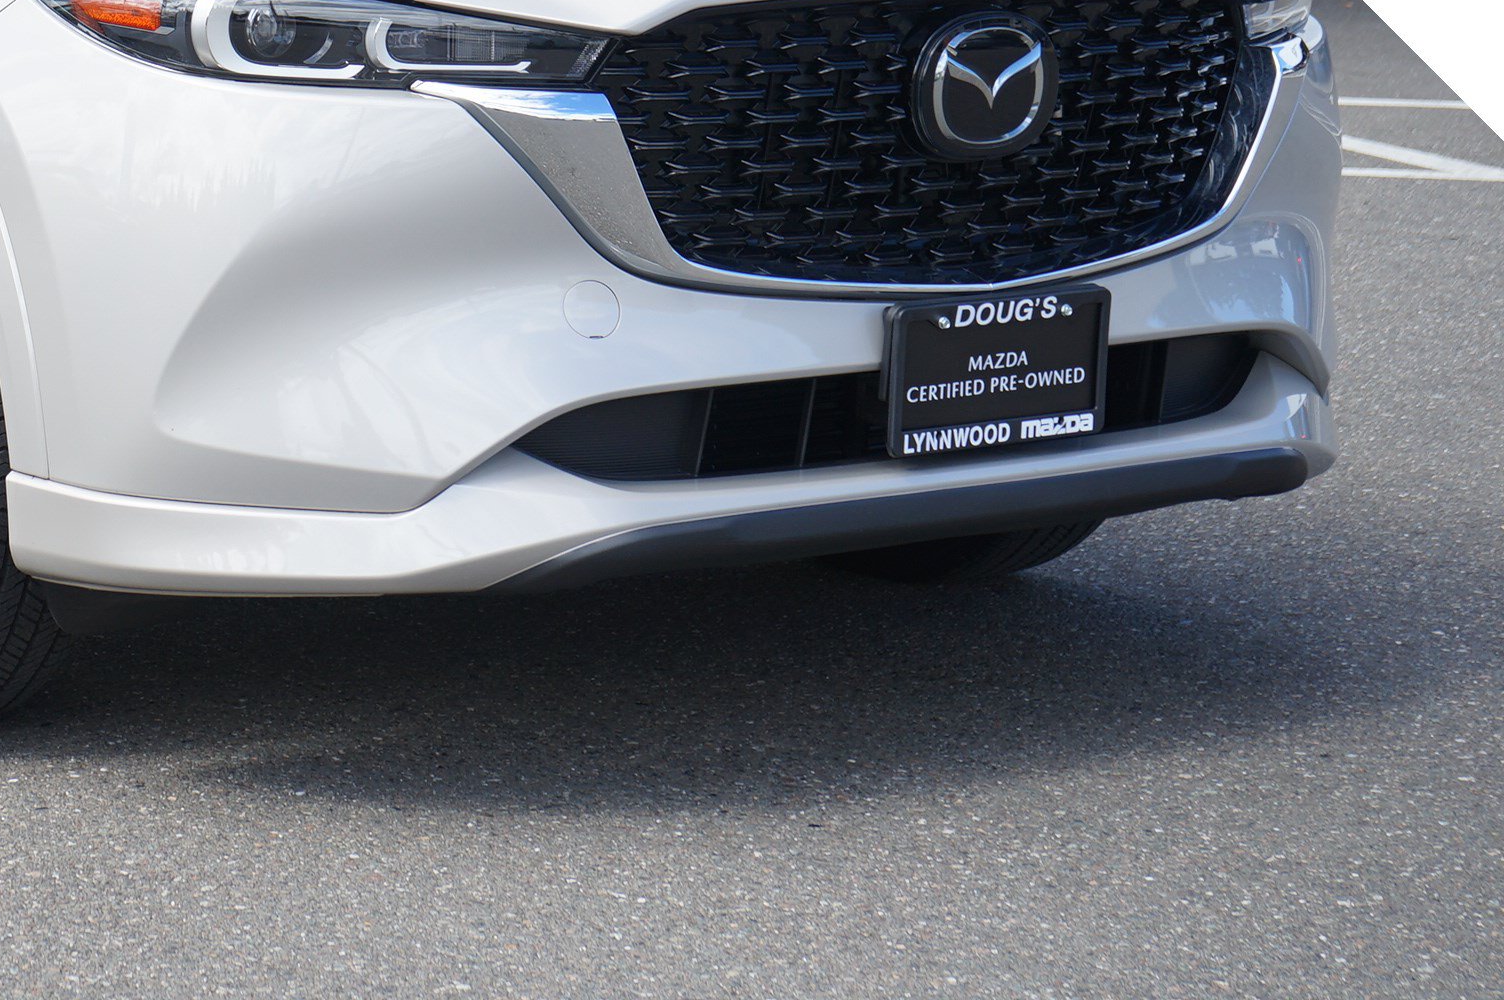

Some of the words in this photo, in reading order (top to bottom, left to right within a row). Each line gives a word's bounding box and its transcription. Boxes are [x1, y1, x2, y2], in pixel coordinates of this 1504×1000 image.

[954, 296, 1058, 328] DOUG'S
[968, 350, 1028, 372] MAZDA
[906, 378, 985, 403] CERTIFIED
[990, 367, 1086, 394] PRE-OWNED
[903, 422, 1011, 455] LYNNWOOD
